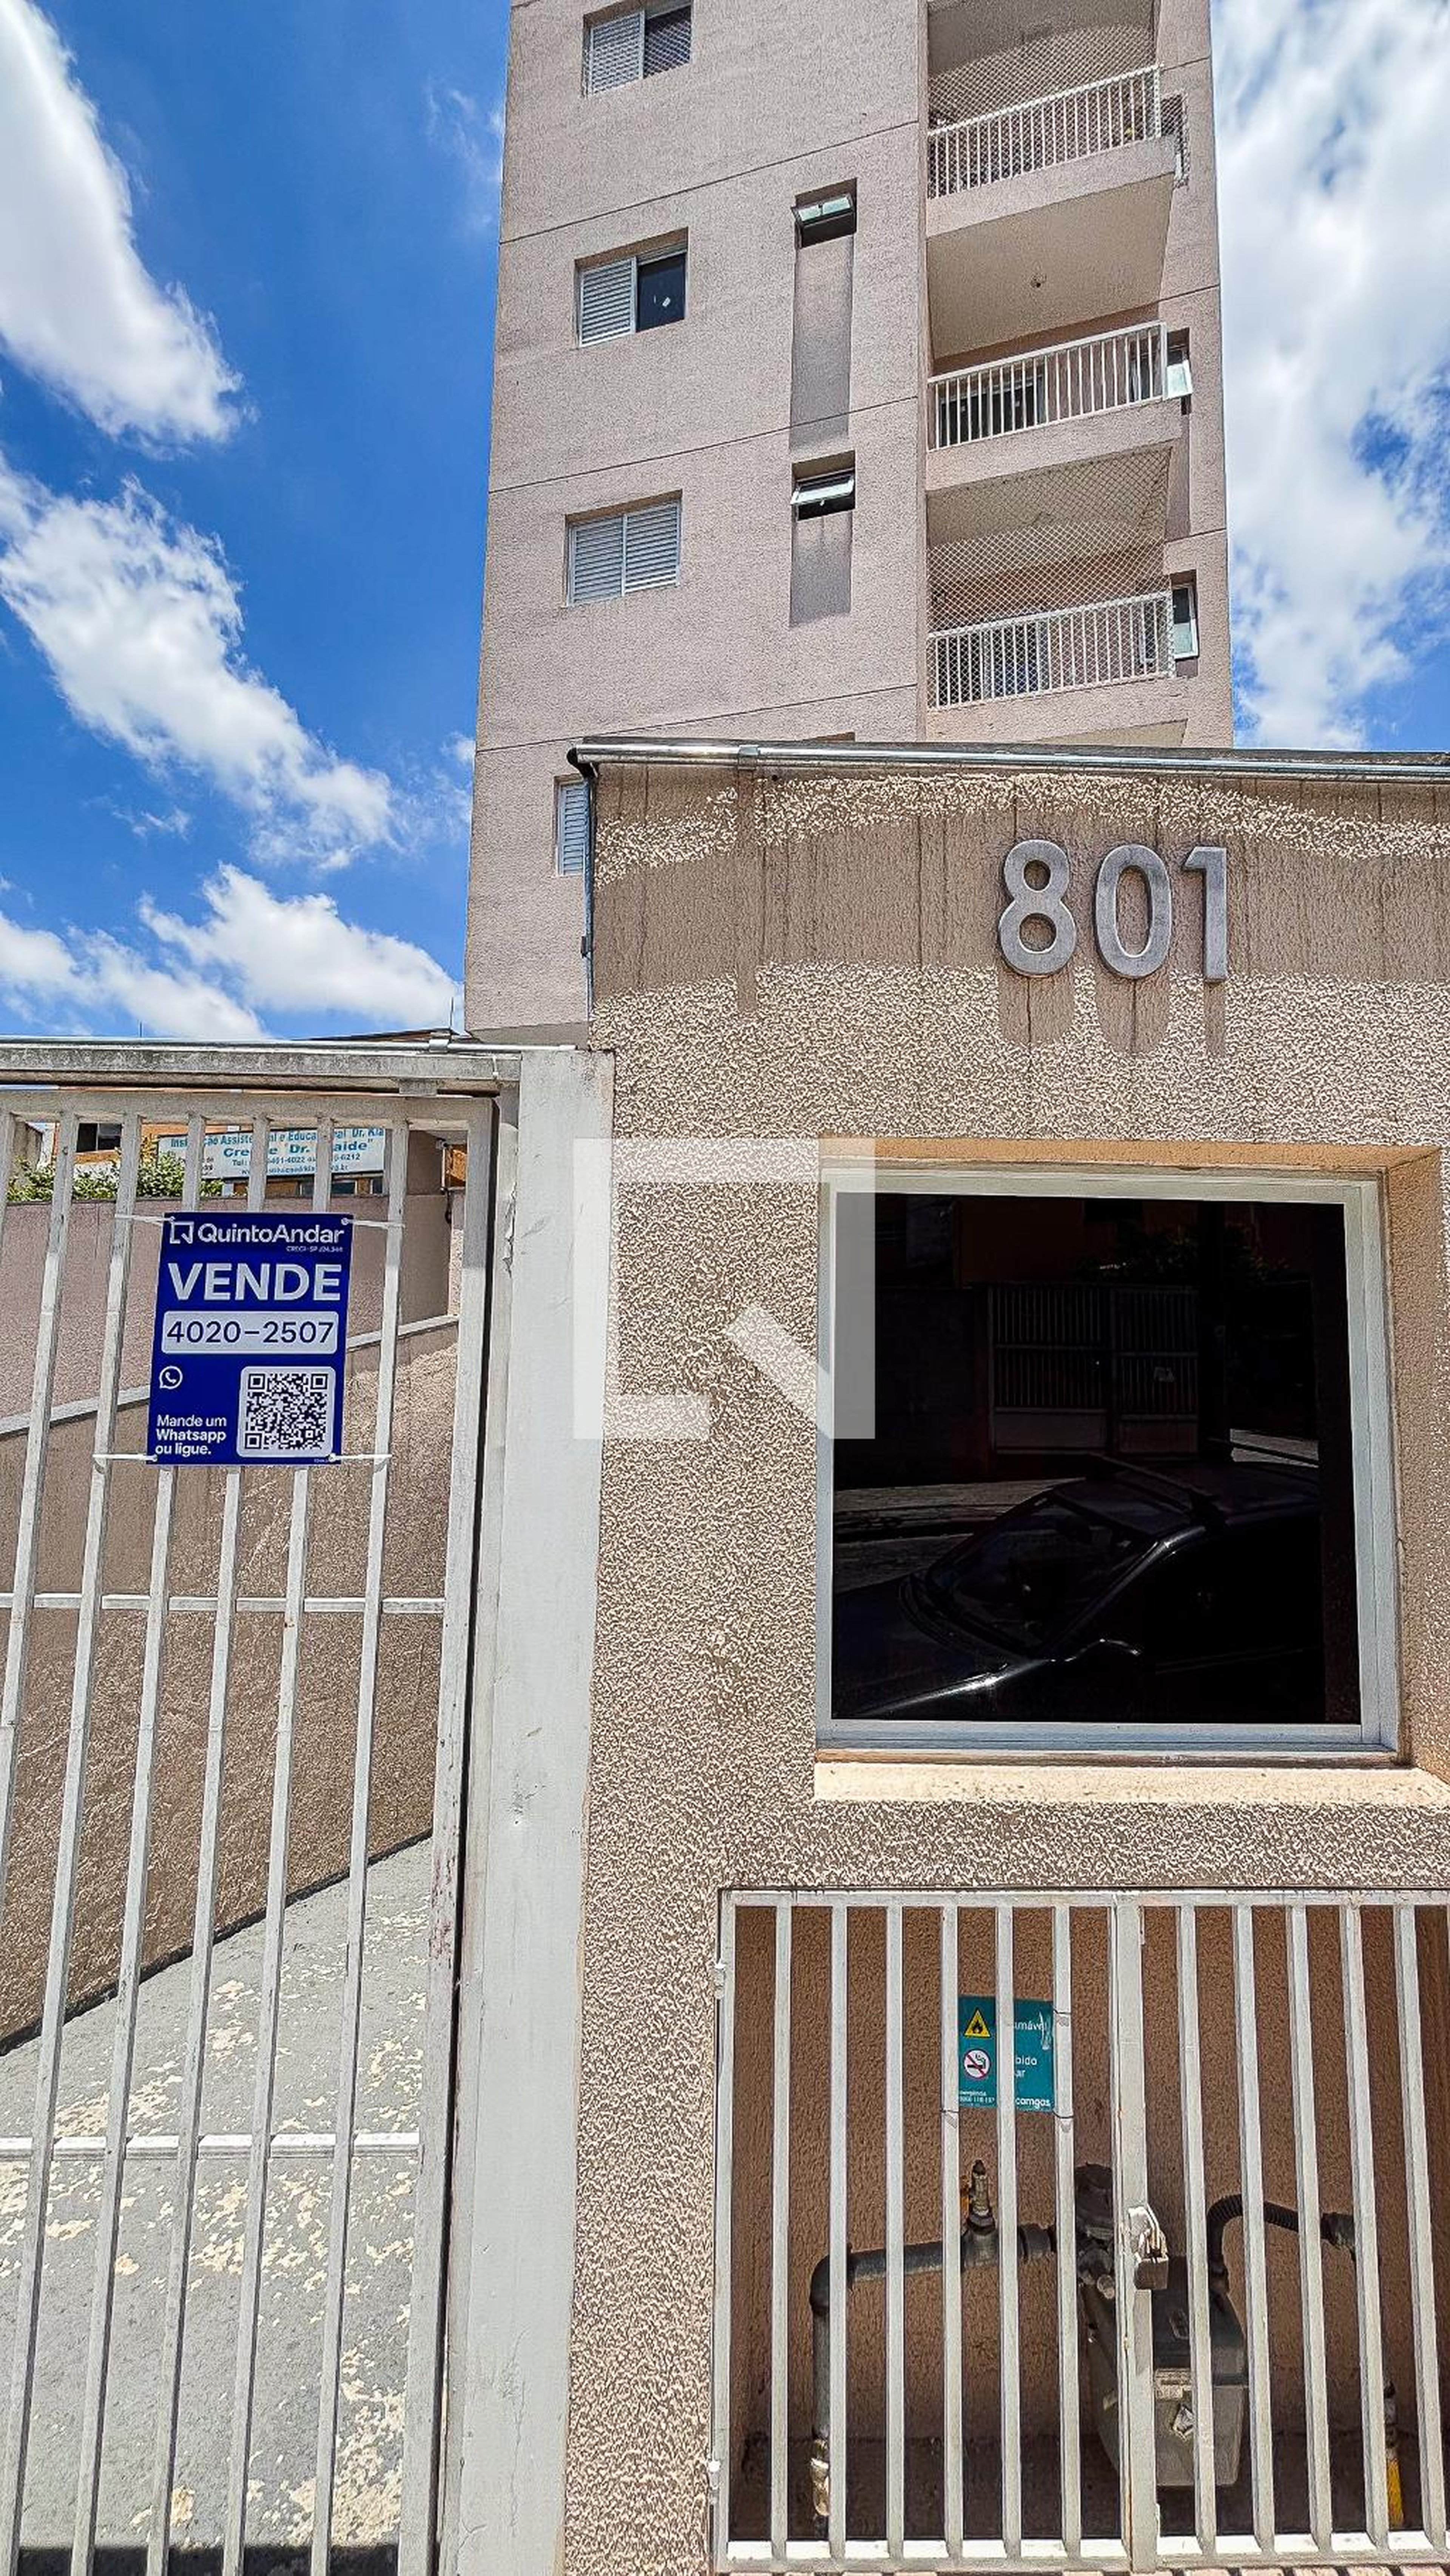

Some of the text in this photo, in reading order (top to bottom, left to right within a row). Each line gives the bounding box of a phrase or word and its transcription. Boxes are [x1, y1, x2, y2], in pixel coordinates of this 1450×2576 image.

[998, 839, 1227, 980] 801
[224, 1147, 278, 1157] Cree
[197, 1223, 344, 1243] QuintoAndar
[168, 1263, 342, 1301] VENDE
[166, 1321, 334, 1343] 4020-2507
[157, 1414, 227, 1427] Mande um
[156, 1429, 227, 1443] Whatsapp
[155, 1442, 212, 1457] ou ligue.
